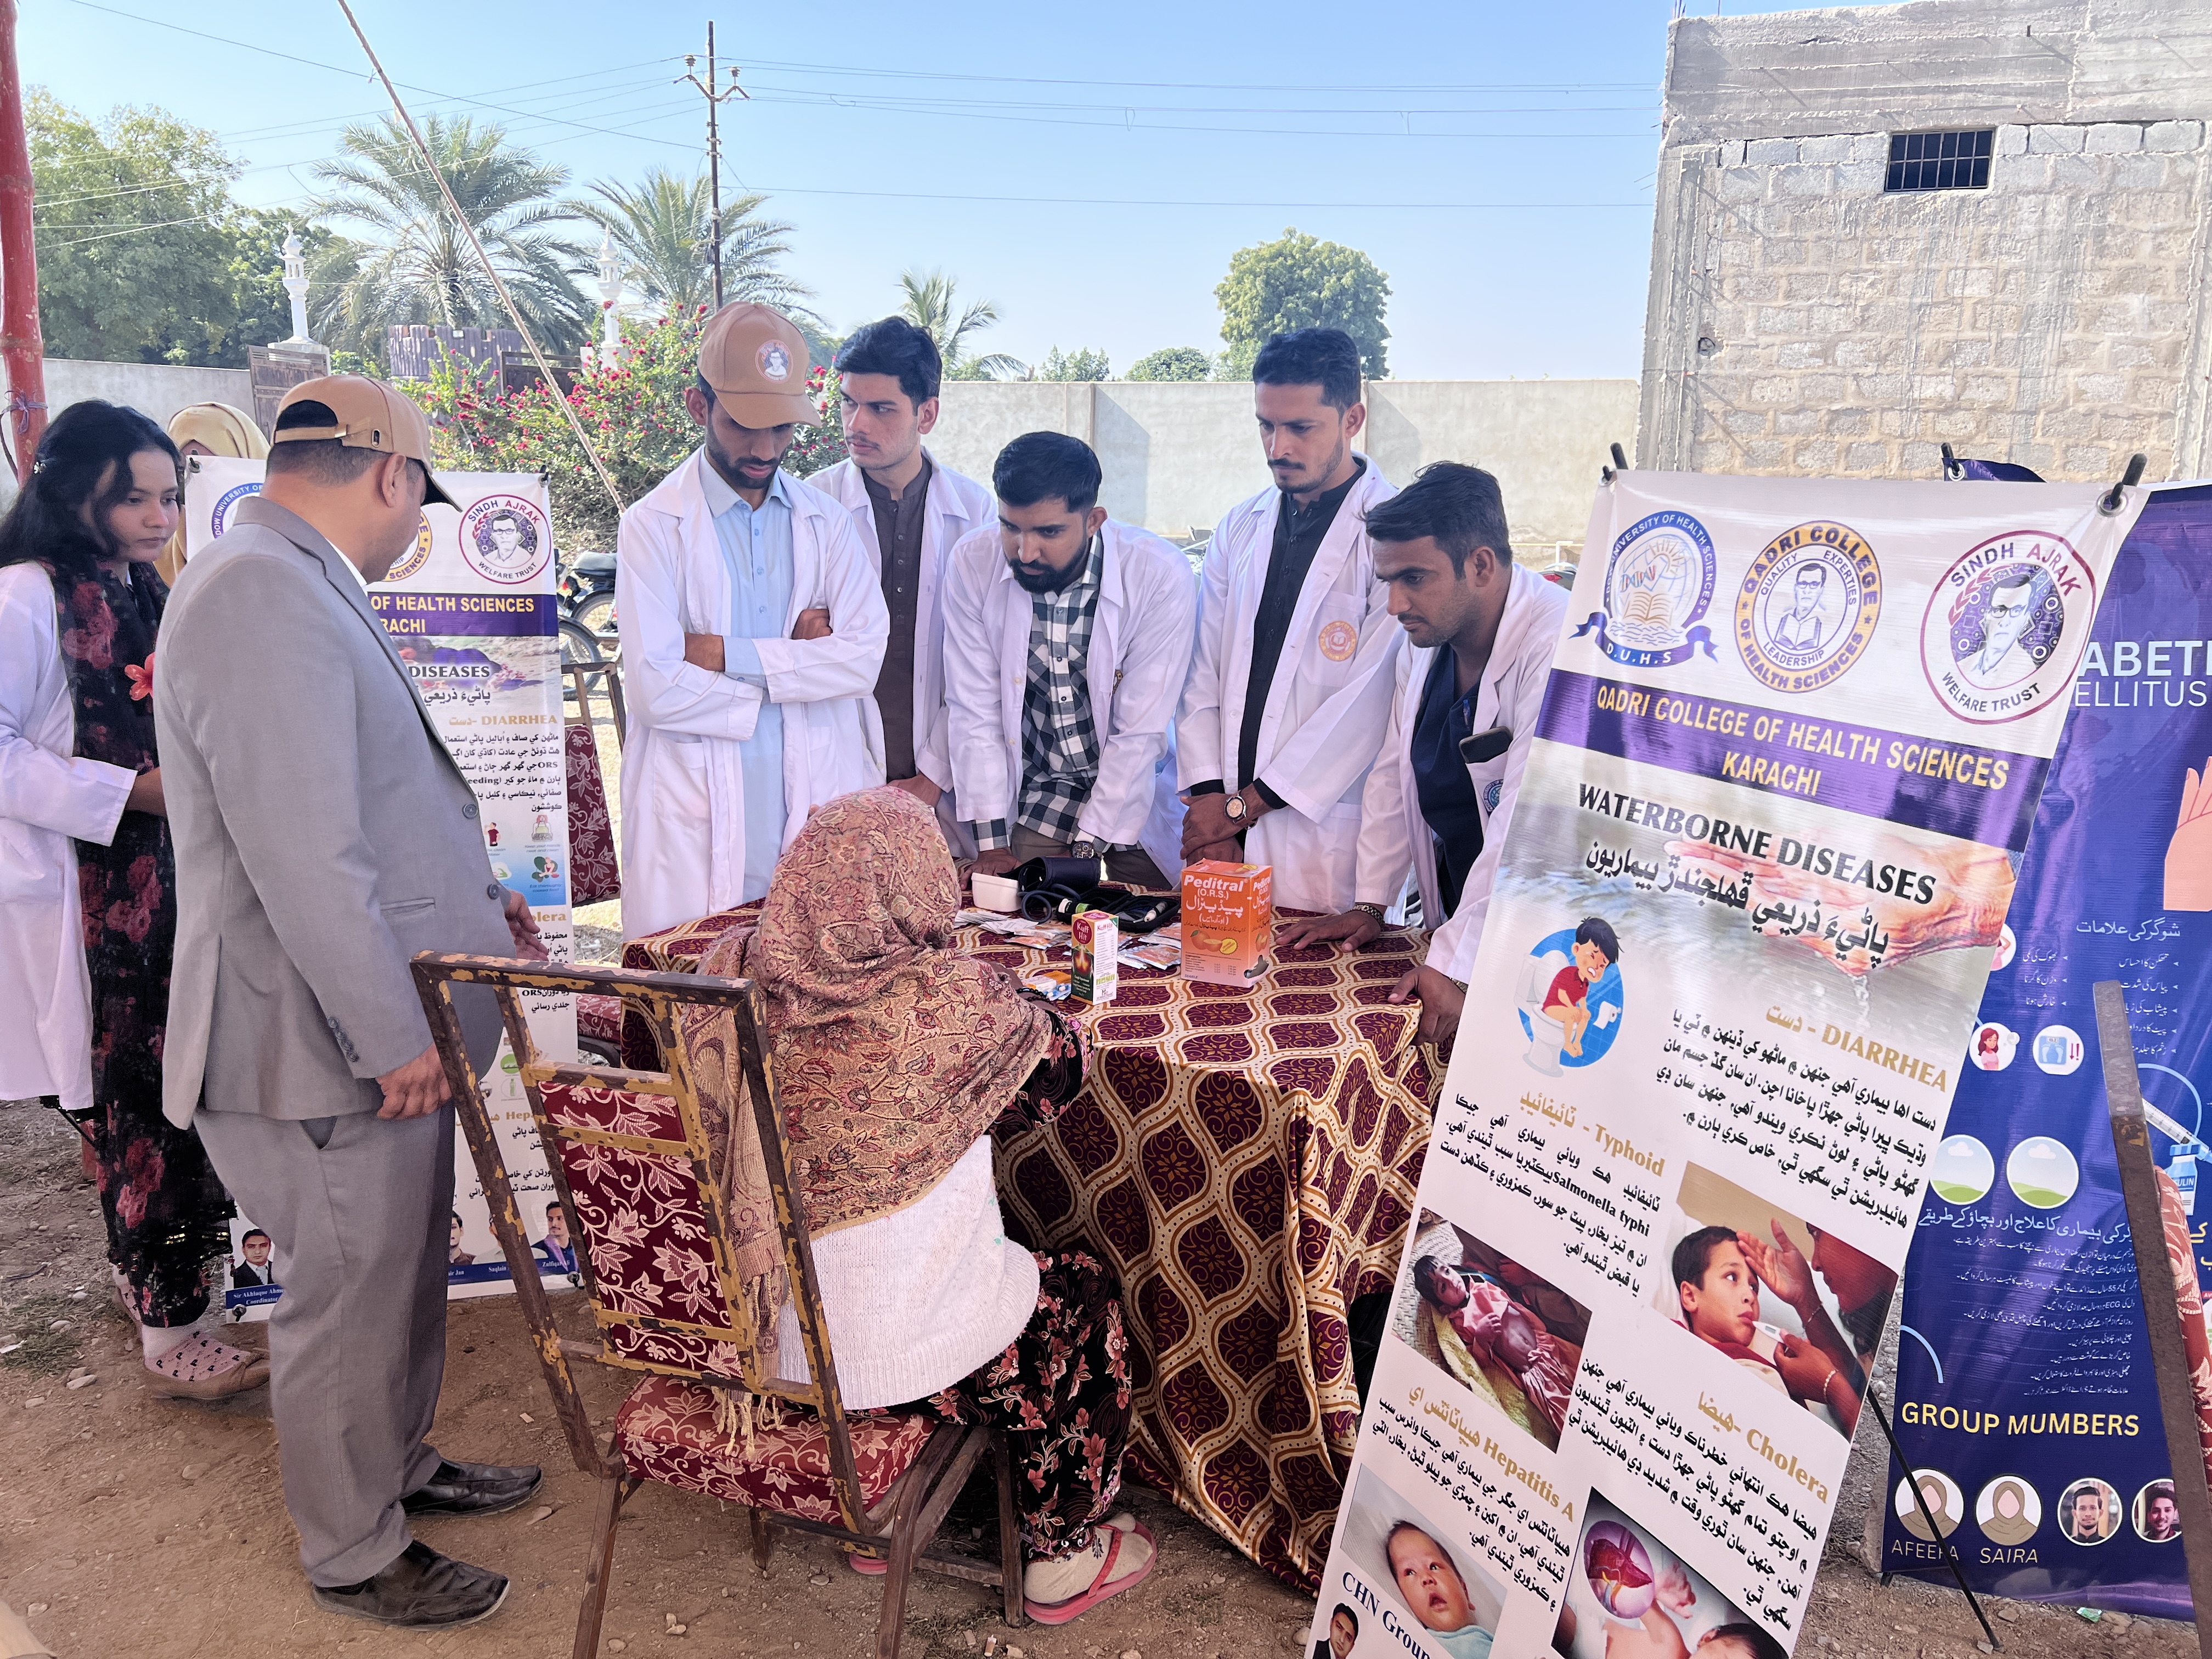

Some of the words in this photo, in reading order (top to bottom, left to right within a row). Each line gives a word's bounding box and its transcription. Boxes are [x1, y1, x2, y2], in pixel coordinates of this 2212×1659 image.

[216, 486, 250, 516] UNIVERSITY
[468, 500, 498, 522] SINDH
[505, 500, 540, 524] AJRAK
[389, 546, 426, 579] SCIENCES
[478, 561, 514, 579] WELFARE
[515, 562, 537, 578] TRUST
[1611, 516, 1660, 563] UNIVERSITY
[1662, 514, 1675, 524] OF
[1677, 516, 1707, 545] HEALTH
[1699, 545, 1713, 606] SCIENCES
[1743, 531, 1801, 594] QADRI
[1810, 527, 1878, 606] COLLEGE
[1951, 542, 2014, 587] SINDH
[2026, 543, 2082, 597] AJRAK
[1760, 552, 1798, 596] QUALITY
[1823, 550, 1857, 605] EXPERTIES
[371, 596, 391, 611] OF
[396, 596, 456, 611] HEALTH
[461, 598, 534, 612] SCIENCES
[380, 618, 426, 633] RACHI
[1740, 618, 1752, 641] OF
[1743, 643, 1790, 689] HEALTH
[1763, 641, 1825, 667] LEADERSHIP
[1793, 631, 1864, 690] SCIENCES
[2078, 640, 2212, 677] ABET
[409, 665, 490, 678] DISEASES
[1942, 672, 1988, 713] WELFARE
[1991, 682, 2041, 712] TRUST
[2075, 681, 2207, 707] ELLITUS
[481, 715, 557, 725] DIARRHEA
[1596, 686, 1652, 717] QADRI
[1654, 696, 1750, 738] COLLEGE
[1752, 715, 1782, 745] OF
[1787, 721, 1882, 765] HEALTH
[1886, 741, 2010, 790] SCIENCES
[1721, 751, 1821, 796] KARACHI
[1579, 783, 1772, 860] WATERBORNE
[1776, 837, 1937, 905] DISEASES
[1184, 874, 1244, 892] Peditral
[1197, 888, 1229, 900] (O.R.S.)
[1077, 922, 1090, 933] Kuff
[1079, 931, 1087, 941] Hit
[1724, 1063, 1745, 1080] سان
[1821, 1023, 1948, 1093] DIARRHEA
[1854, 1087, 1891, 1115] بيماري
[1911, 1110, 1936, 1132] دست
[1494, 1143, 1514, 1159] سبب
[1517, 1127, 1545, 1152] بيماري
[1594, 1124, 1666, 1177] Typhoid
[1618, 1209, 1650, 1237] typhi
[1378, 1396, 1396, 1415] سبب
[1624, 1390, 1655, 1420] بيماري
[1901, 1402, 2000, 1436] GROUP
[2007, 1413, 2140, 1436] MUMBERS
[1456, 1460, 1482, 1488] بيماري
[1483, 1437, 1559, 1507] Hepatitis
[1561, 1501, 1574, 1522] A
[1746, 1427, 1830, 1504] Cholera
[1979, 1548, 2039, 1565] SAIRA
[1343, 1572, 1380, 1617] CHN
